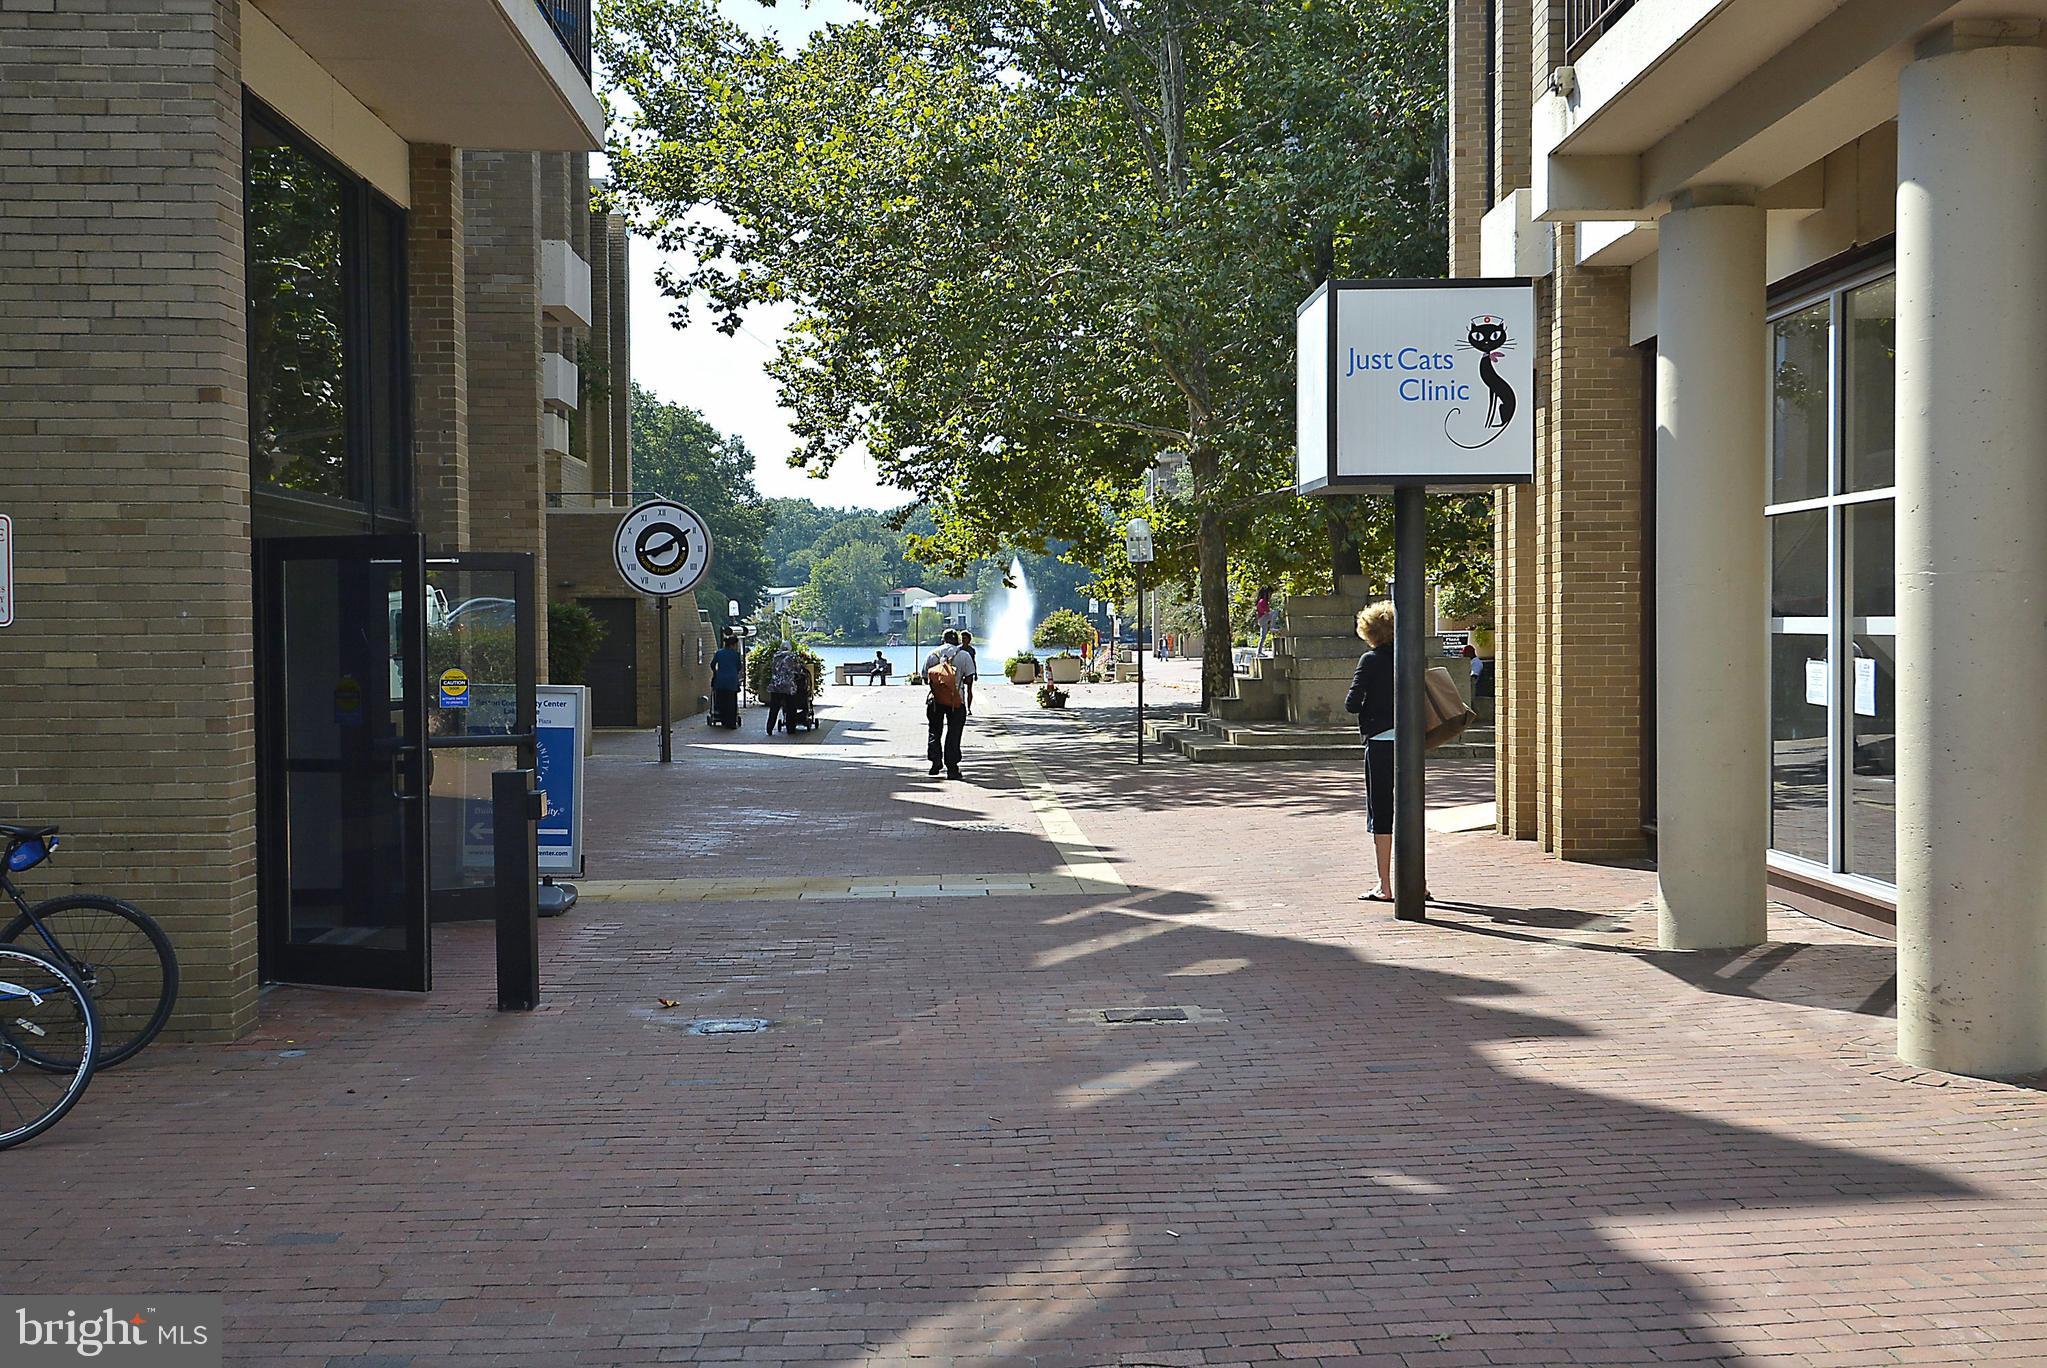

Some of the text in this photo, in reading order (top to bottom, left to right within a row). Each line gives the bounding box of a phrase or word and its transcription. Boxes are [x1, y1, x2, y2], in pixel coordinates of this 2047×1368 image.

[1346, 347, 1454, 377] Just Cats
[1399, 378, 1470, 401] Clinic
[641, 514, 648, 522] XI
[678, 577, 684, 585] V
[659, 582, 666, 590] VI
[543, 700, 567, 708] Center
